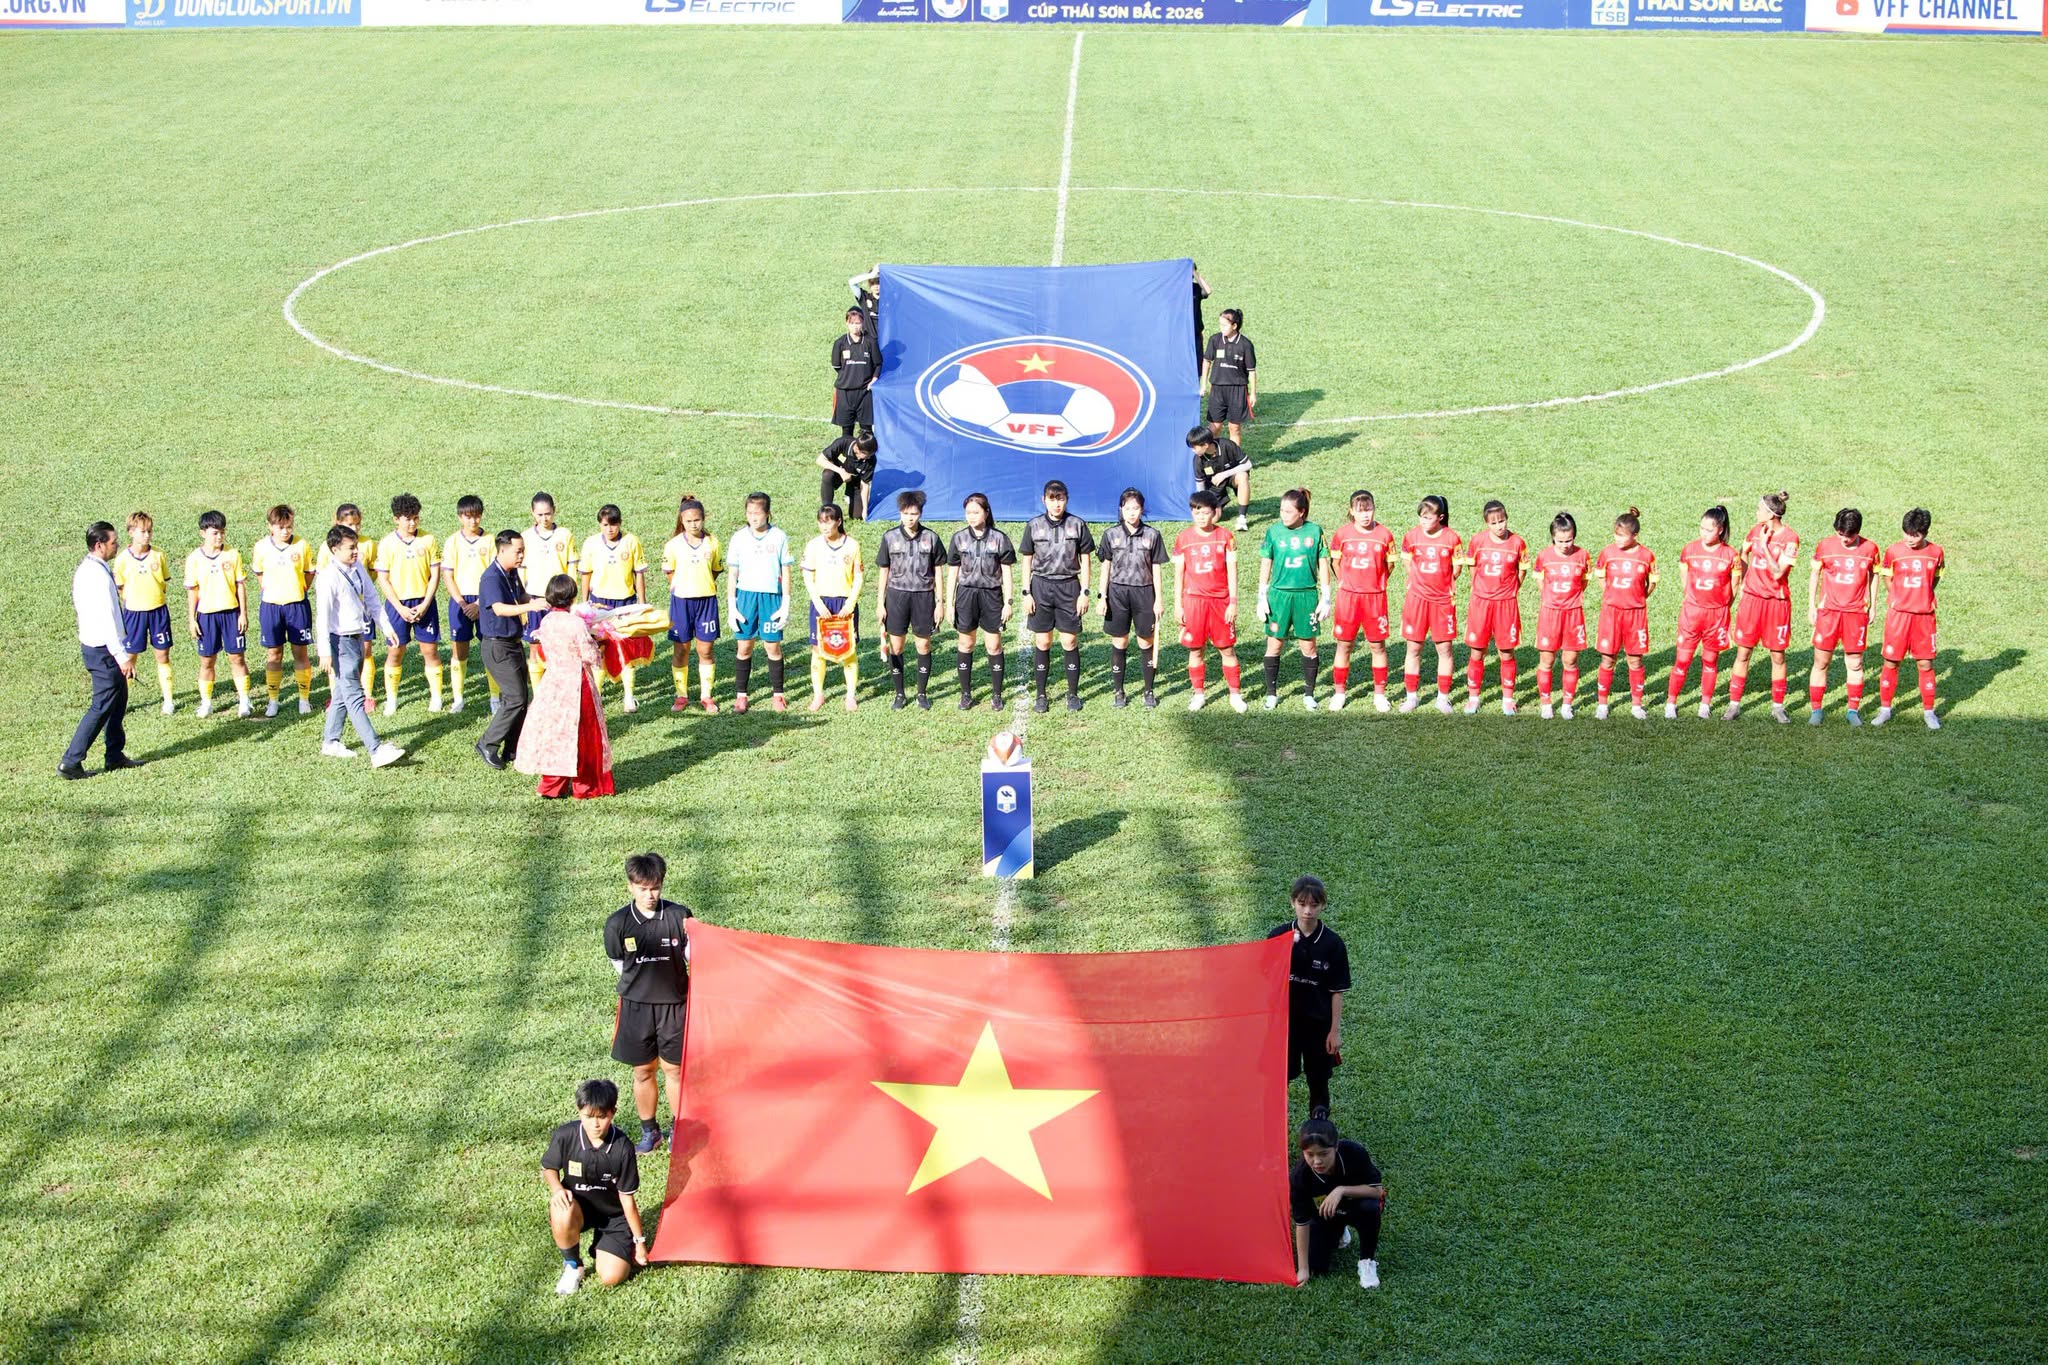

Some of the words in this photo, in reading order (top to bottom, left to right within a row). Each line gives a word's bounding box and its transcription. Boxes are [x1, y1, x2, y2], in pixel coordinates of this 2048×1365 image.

[645, 0, 686, 12] LS
[690, 0, 795, 12] ELECTRIC
[1028, 3, 1058, 18] CÚP
[1061, 3, 1094, 18] THÁI
[1098, 6, 1128, 19] SƠN
[1165, 7, 1204, 20] 2026
[1370, 0, 1415, 16] LS
[1414, 1, 1524, 18] ELECTRIC
[1919, 0, 2018, 19] CHANNEL
[1594, 11, 1625, 23] TSB
[1006, 422, 1064, 437] VFF
[1195, 561, 1214, 574] LS
[1284, 555, 1306, 569] LS
[1351, 557, 1369, 570] LS
[1420, 562, 1439, 574] LS
[1752, 556, 1768, 570] LS
[1484, 564, 1503, 576] LS
[1612, 576, 1632, 589] LS
[1695, 578, 1715, 591] LS
[1836, 572, 1855, 585] LS
[1903, 576, 1922, 588] LS
[1552, 580, 1572, 593] LS
[702, 620, 717, 634] 70
